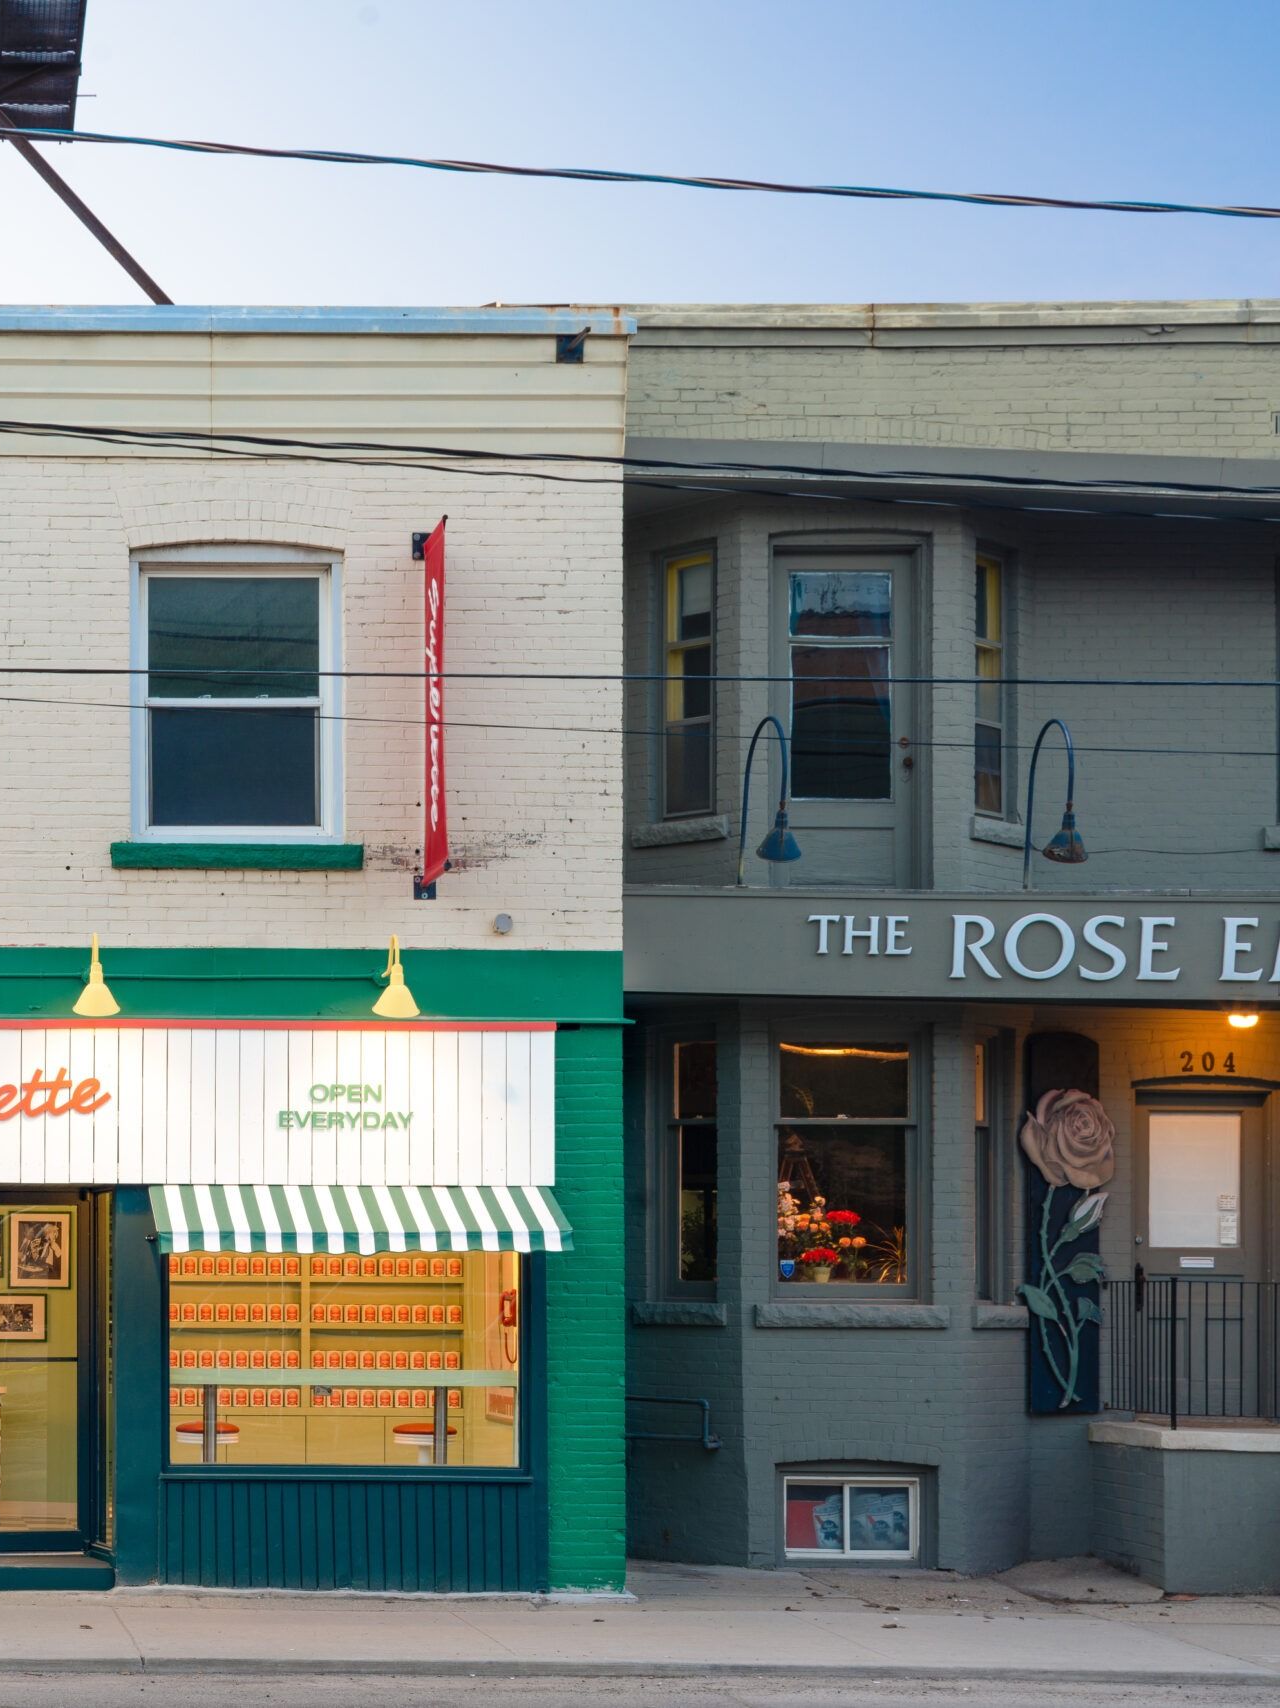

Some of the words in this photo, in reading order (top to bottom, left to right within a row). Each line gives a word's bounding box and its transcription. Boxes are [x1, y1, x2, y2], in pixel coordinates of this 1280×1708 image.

[807, 914, 913, 955] THE
[948, 913, 1181, 981] ROSE
[1218, 916, 1280, 982] E
[1179, 1050, 1236, 1073] 204
[308, 1083, 382, 1103] OPEN
[277, 1110, 414, 1130] EVERYDAY
